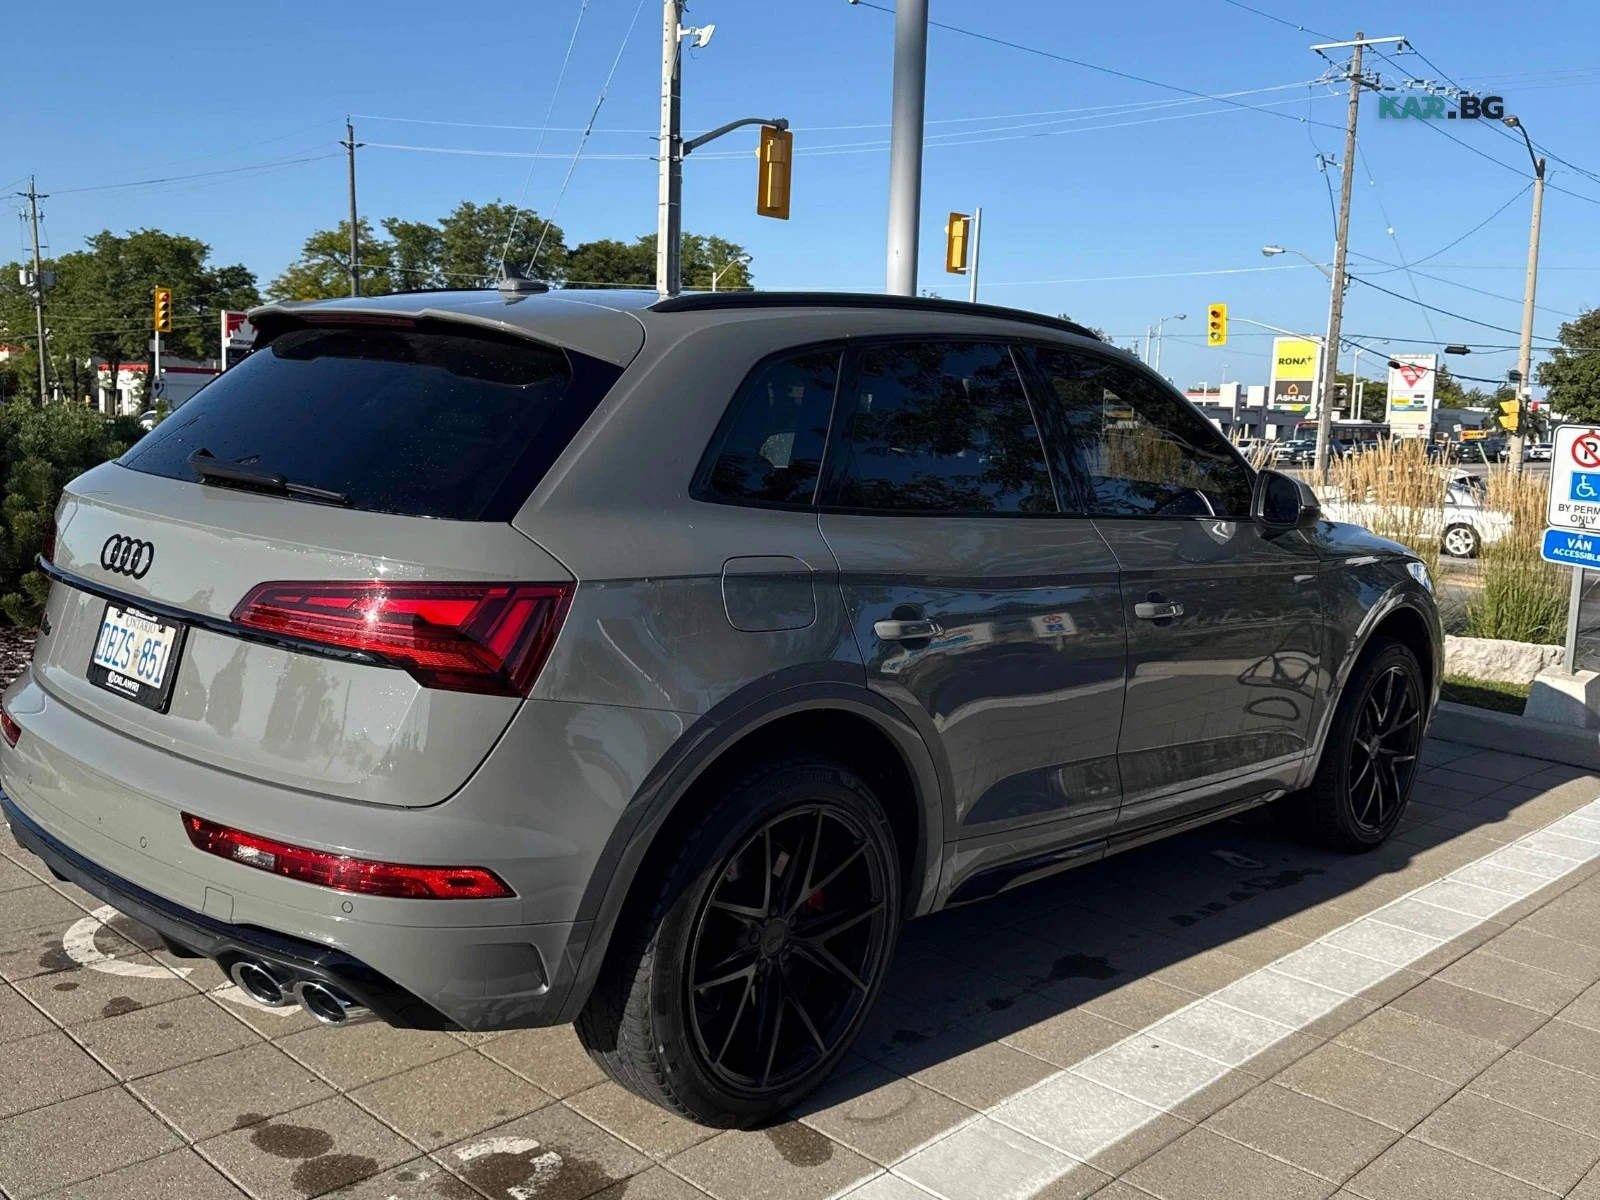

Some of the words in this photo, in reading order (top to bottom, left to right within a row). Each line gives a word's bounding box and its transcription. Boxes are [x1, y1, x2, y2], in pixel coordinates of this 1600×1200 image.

[1276, 394, 1310, 402] ASHLEY
[1558, 503, 1571, 512] BY
[1570, 514, 1597, 524] ONLY
[1567, 537, 1592, 551] VAN
[1552, 547, 1600, 562] ACCESSIBLE
[126, 616, 156, 633] ONTARIO
[137, 638, 168, 684] 851
[113, 674, 140, 692] DILAWRI
